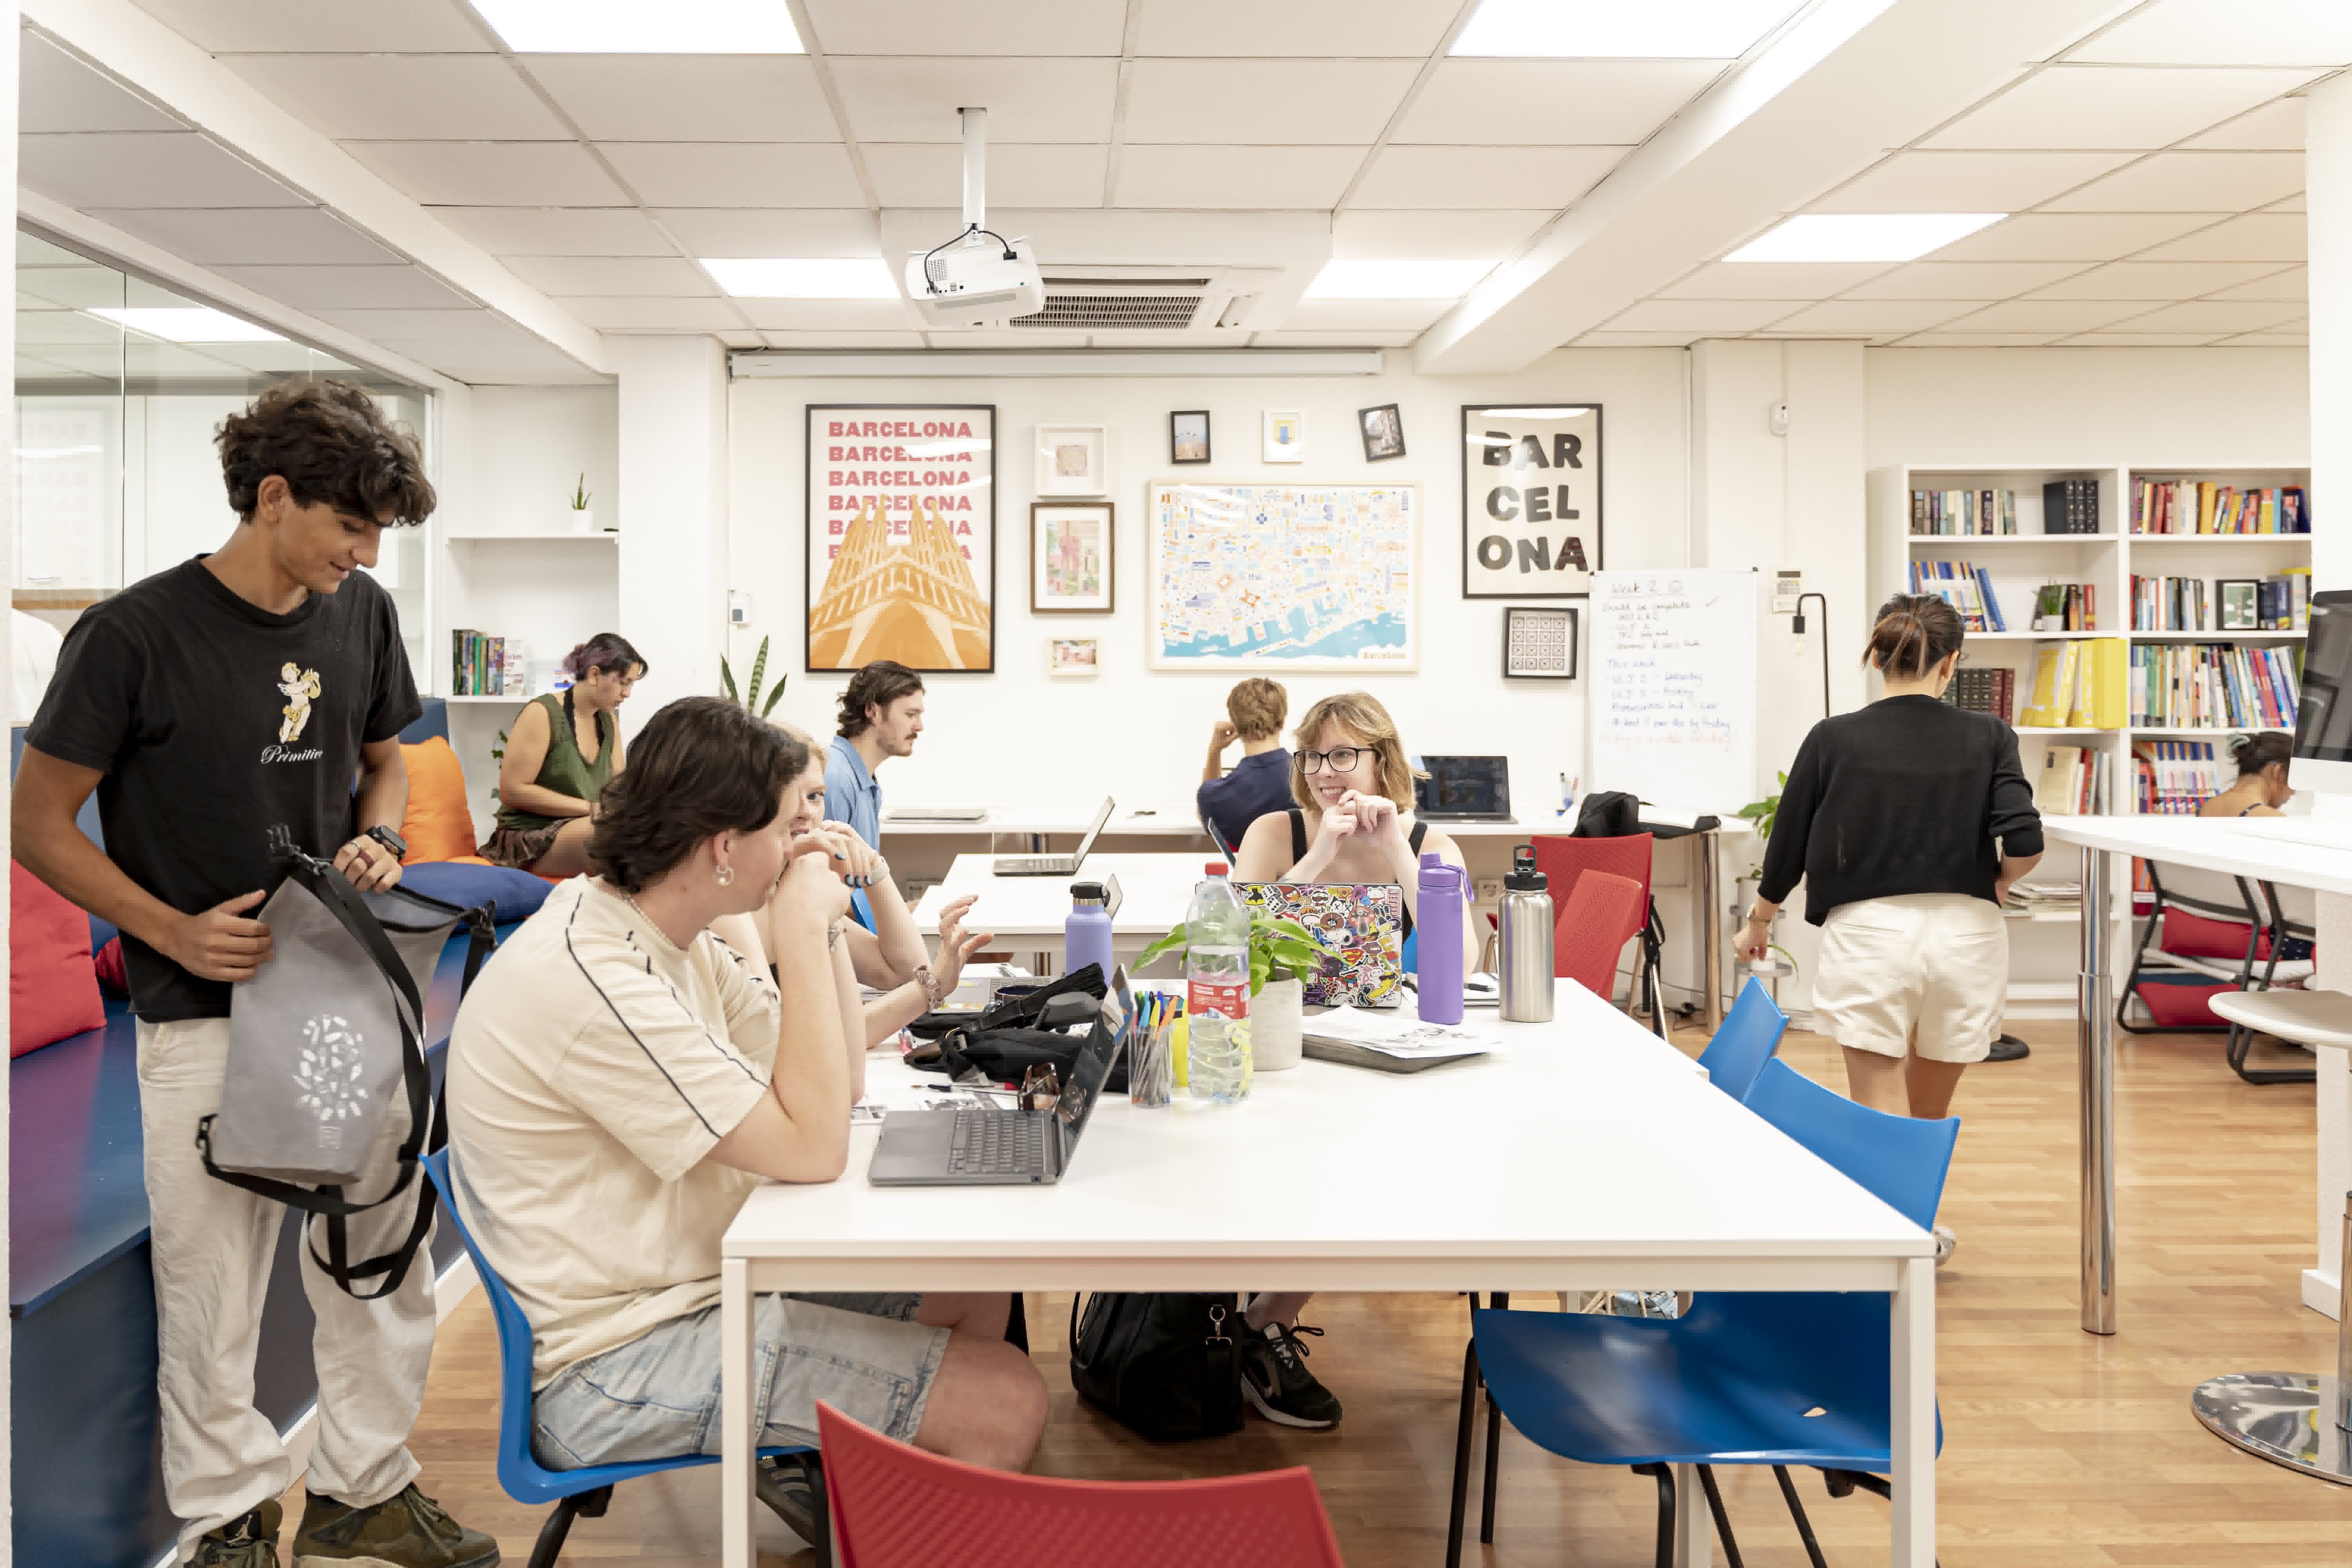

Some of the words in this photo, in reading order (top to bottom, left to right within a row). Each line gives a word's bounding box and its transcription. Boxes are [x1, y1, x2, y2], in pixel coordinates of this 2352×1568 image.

[829, 422, 973, 437] BARCELONA
[829, 446, 973, 461] BARCEA
[1483, 431, 1583, 468] BAR
[829, 470, 973, 486] BARCELONA
[1486, 485, 1579, 523] CEL
[1477, 535, 1588, 573] ONA
